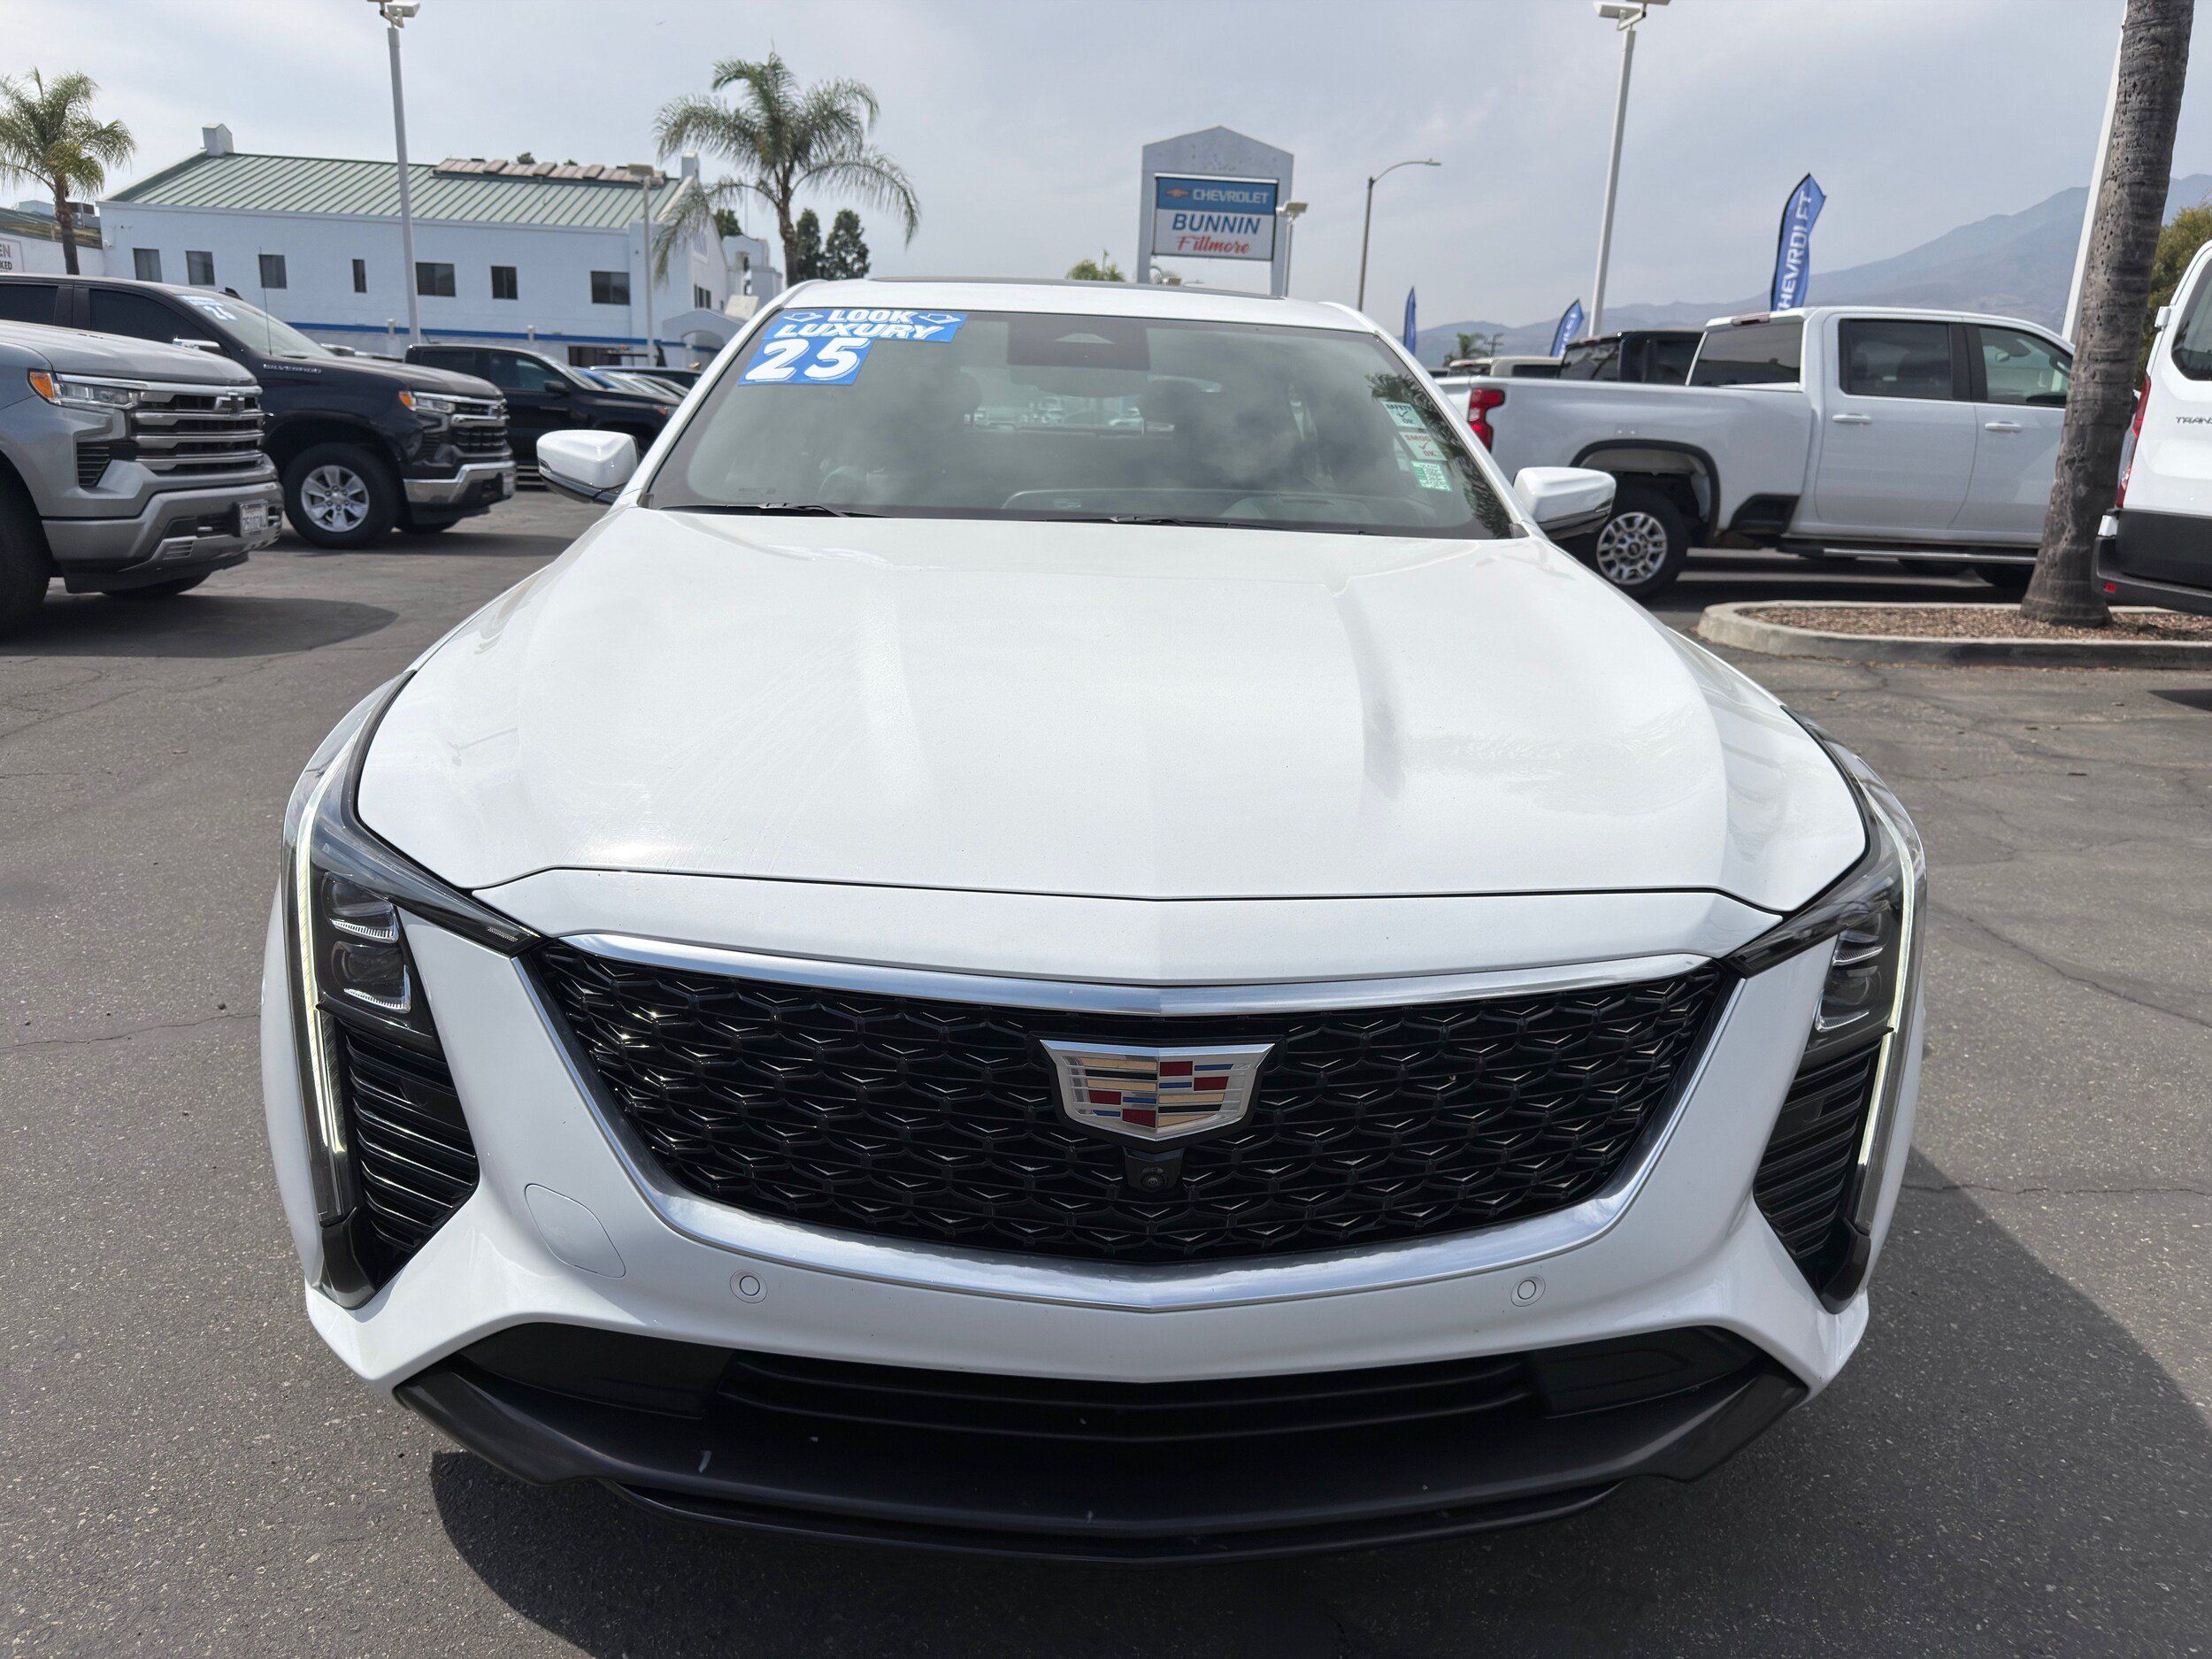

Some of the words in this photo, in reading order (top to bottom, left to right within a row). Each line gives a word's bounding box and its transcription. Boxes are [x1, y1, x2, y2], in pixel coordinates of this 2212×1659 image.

[1192, 188, 1270, 204] CHEVROLET
[1172, 213, 1261, 234] BUNNIN
[1177, 235, 1250, 255] Fillmore
[1777, 189, 1812, 311] HEVROLET
[826, 310, 918, 325] LOOK
[773, 323, 945, 340] LUXURY
[745, 338, 871, 381] 25
